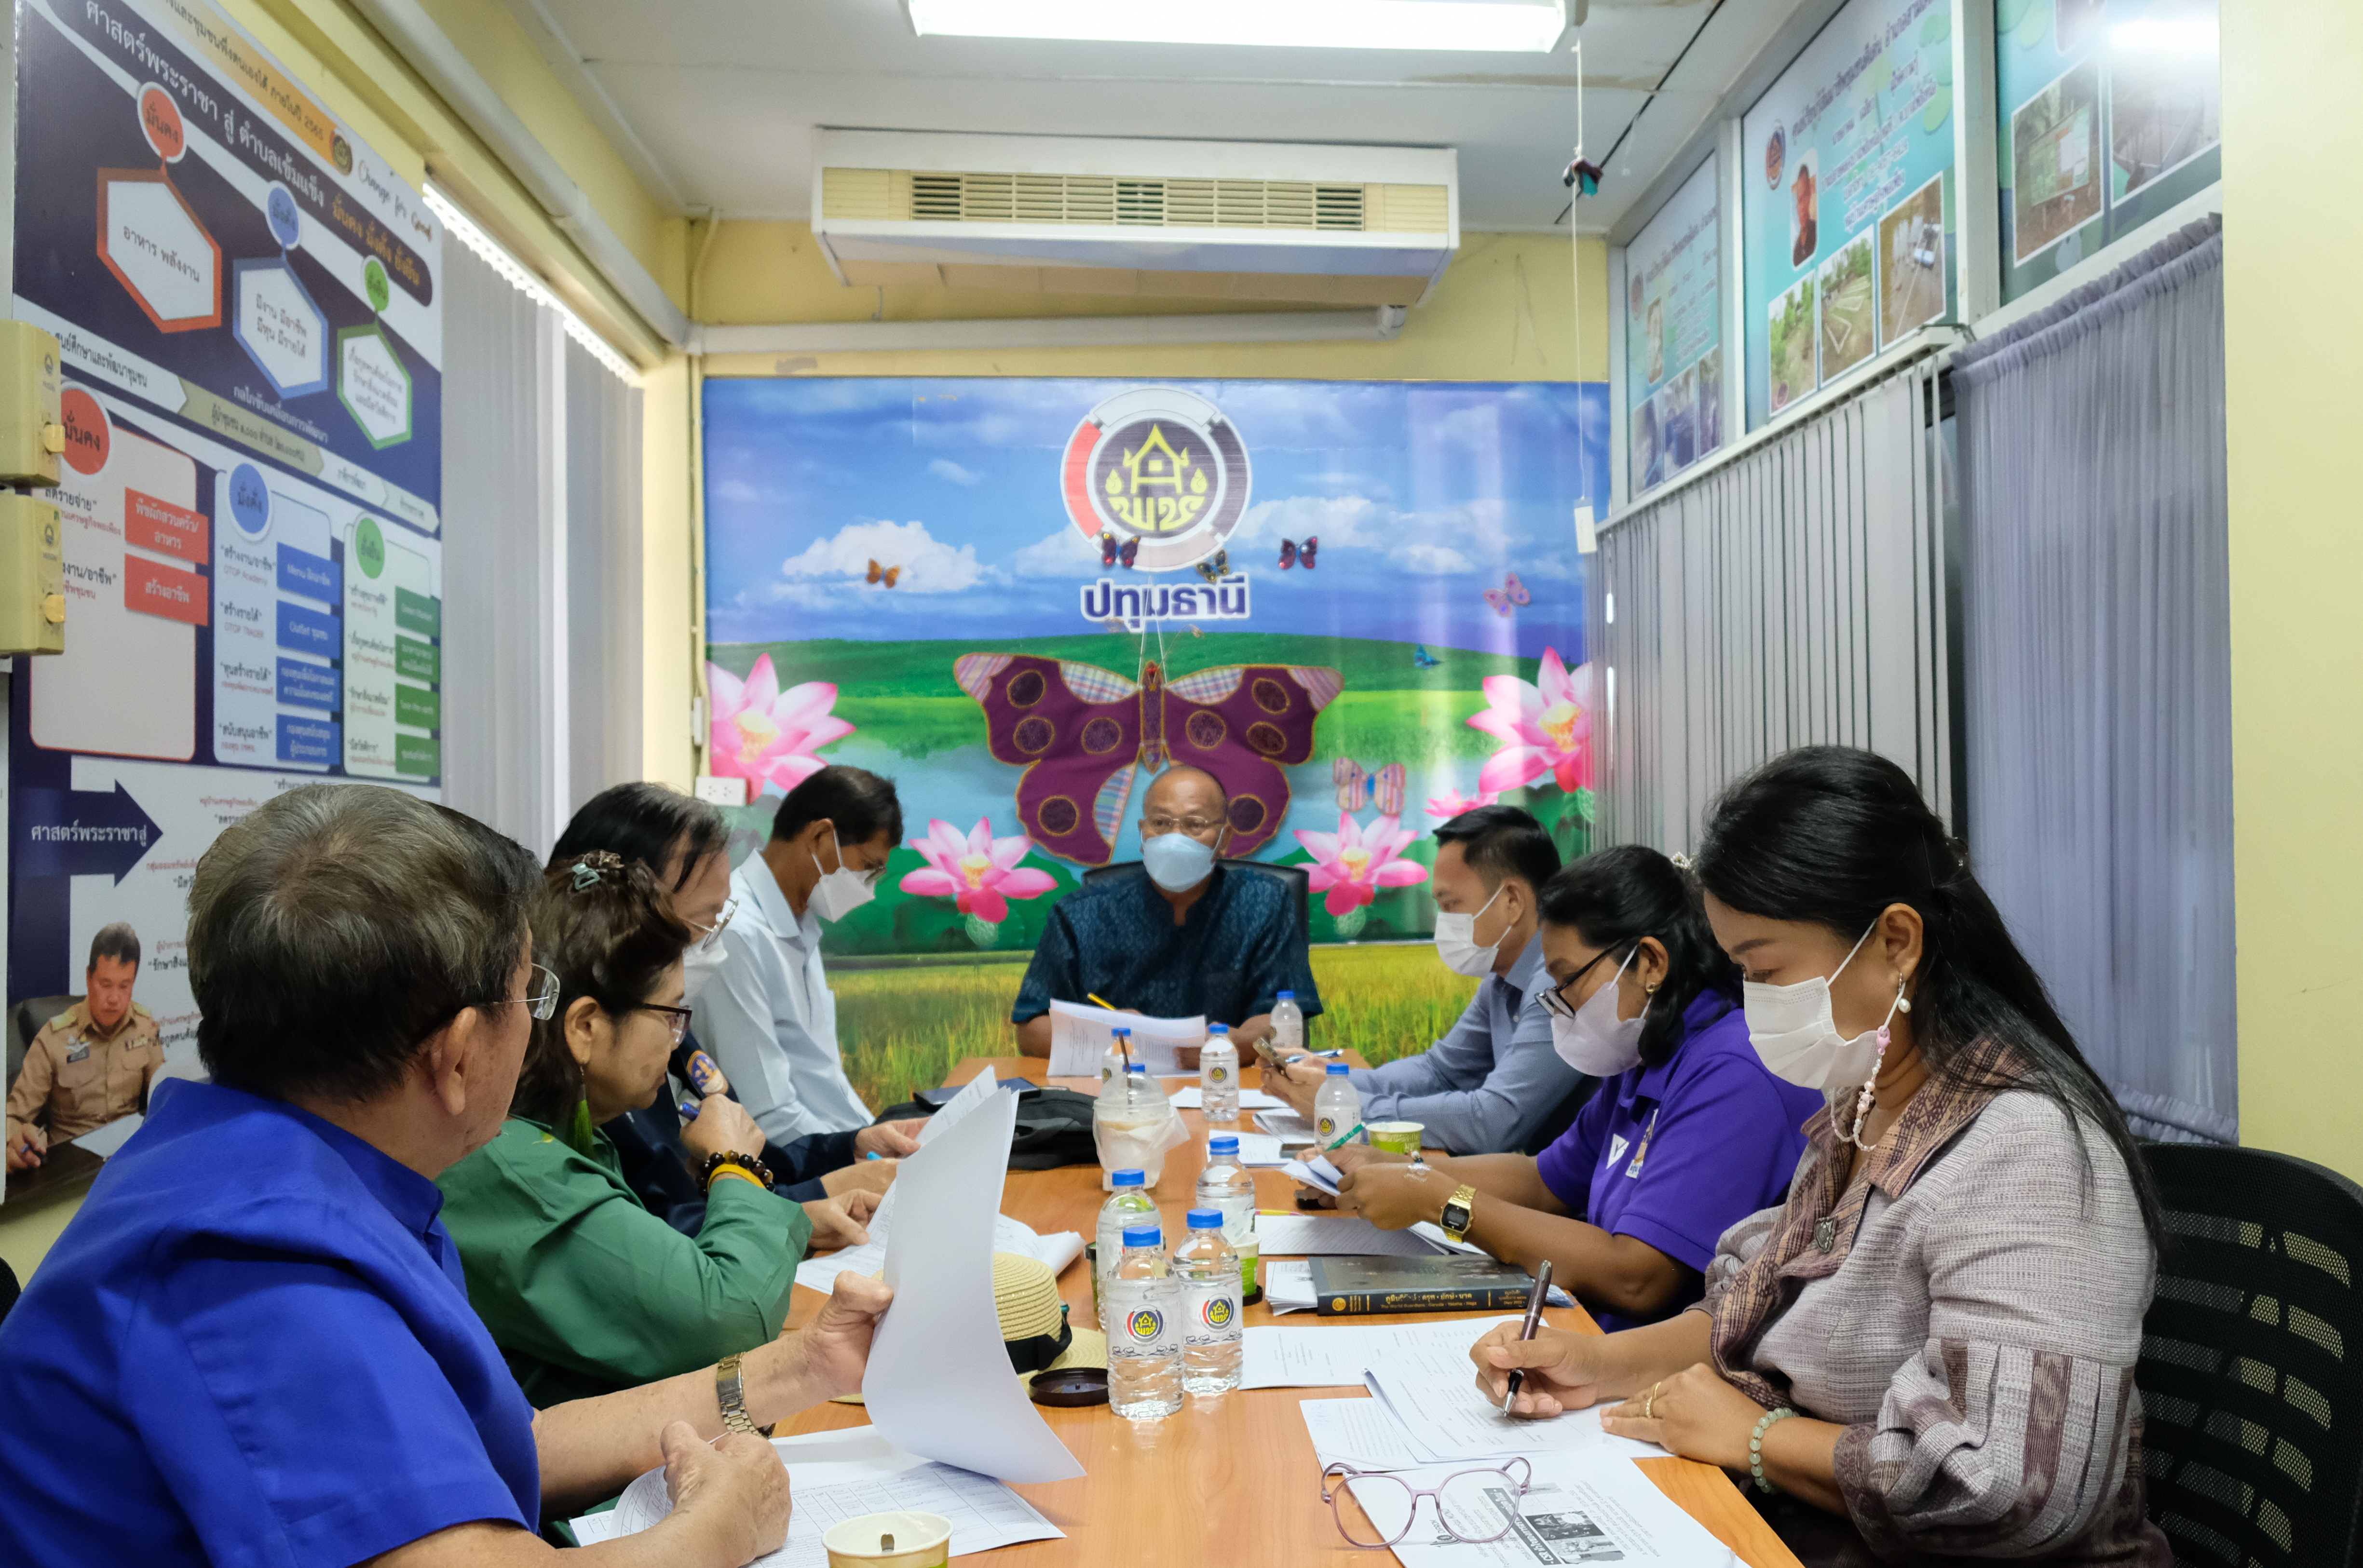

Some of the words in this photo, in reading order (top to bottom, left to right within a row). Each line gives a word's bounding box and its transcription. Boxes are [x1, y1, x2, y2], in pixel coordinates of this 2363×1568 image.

[86, 0, 218, 121] ศาสตร์พระราชา
[224, 109, 235, 145] สู่
[239, 121, 325, 209] ตำบลเข้มแข็ง
[122, 225, 157, 257] อาหาร
[160, 249, 201, 283] พลังงาน
[64, 409, 101, 451] มั่นคง
[1083, 573, 1247, 631] ปทุมธานี
